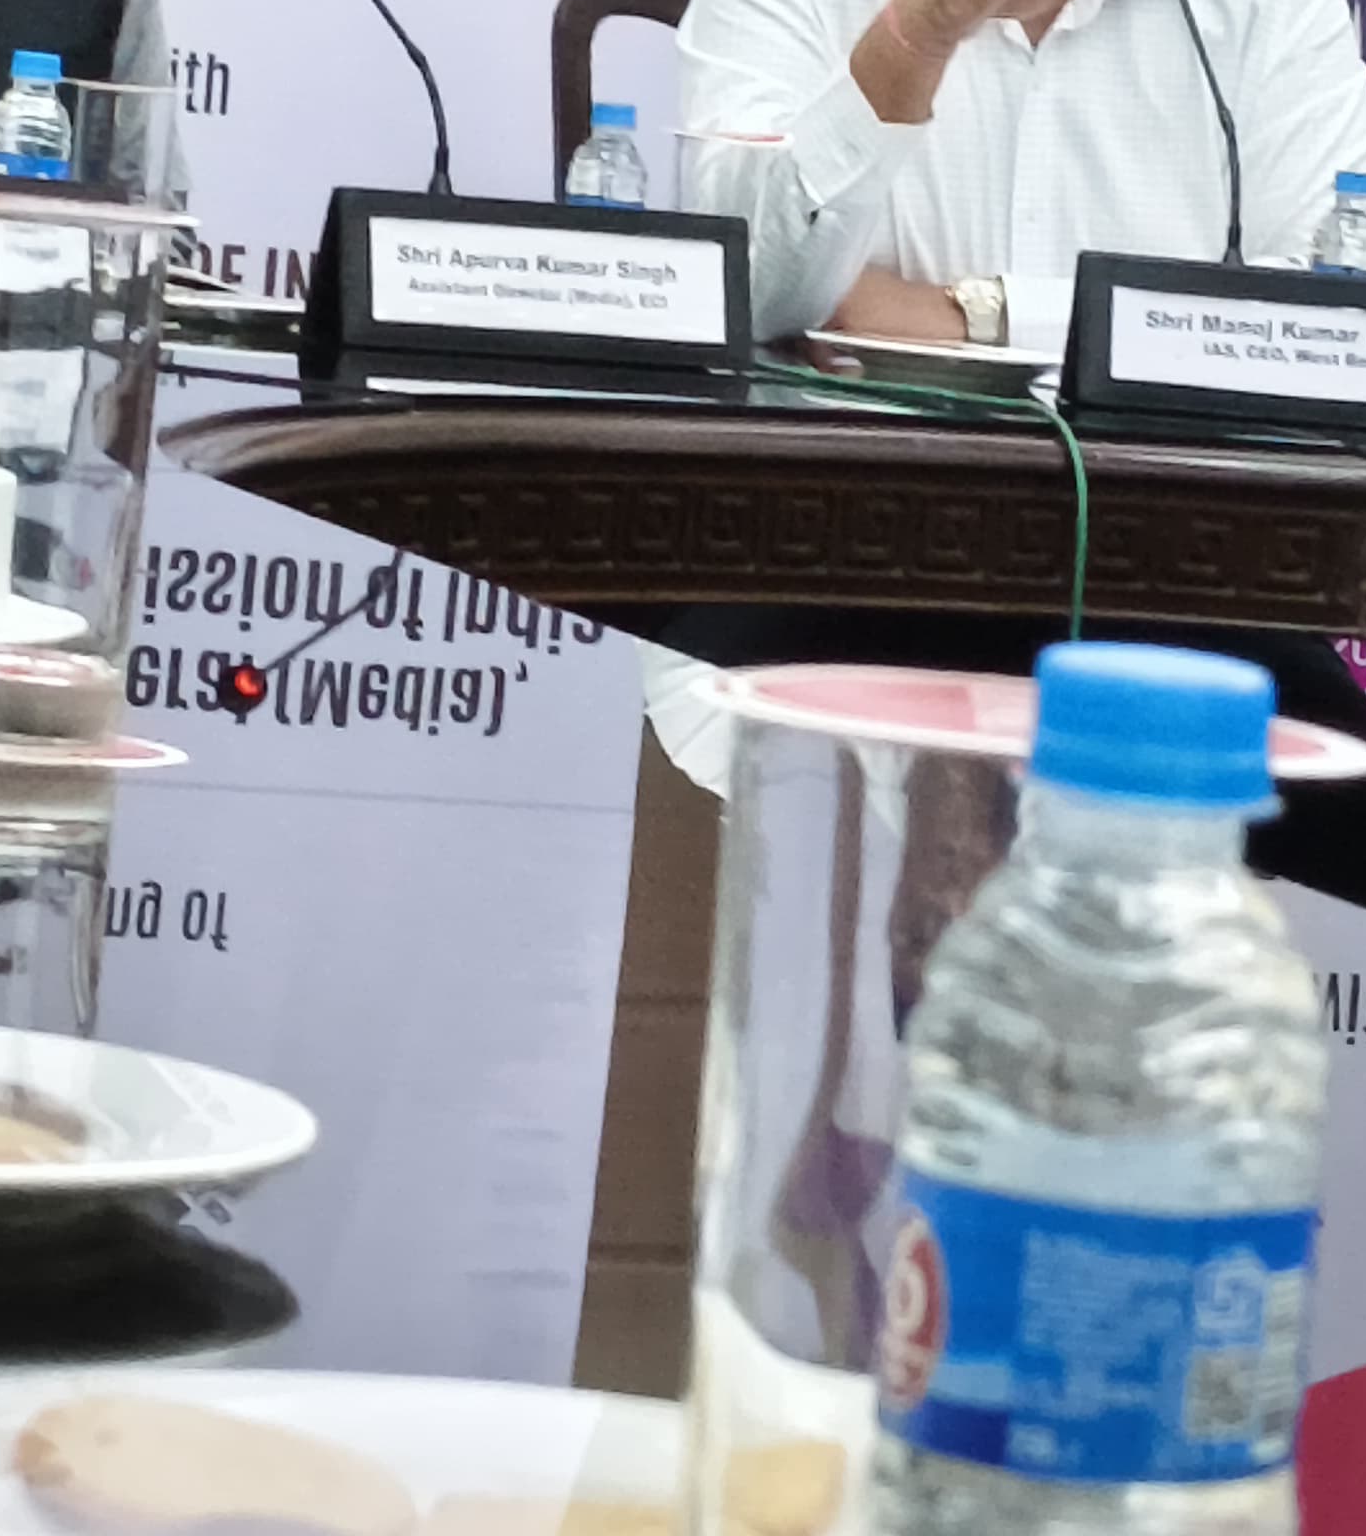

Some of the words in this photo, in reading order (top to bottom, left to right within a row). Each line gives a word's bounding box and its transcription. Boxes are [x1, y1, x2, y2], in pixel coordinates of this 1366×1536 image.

[171, 47, 230, 116] ith
[396, 243, 441, 266] Shri
[536, 254, 609, 277] Kumar
[616, 260, 677, 286] Singh
[1145, 310, 1194, 332] Shri
[1201, 312, 1273, 343] Manoj
[1282, 320, 1360, 343] Kumar
